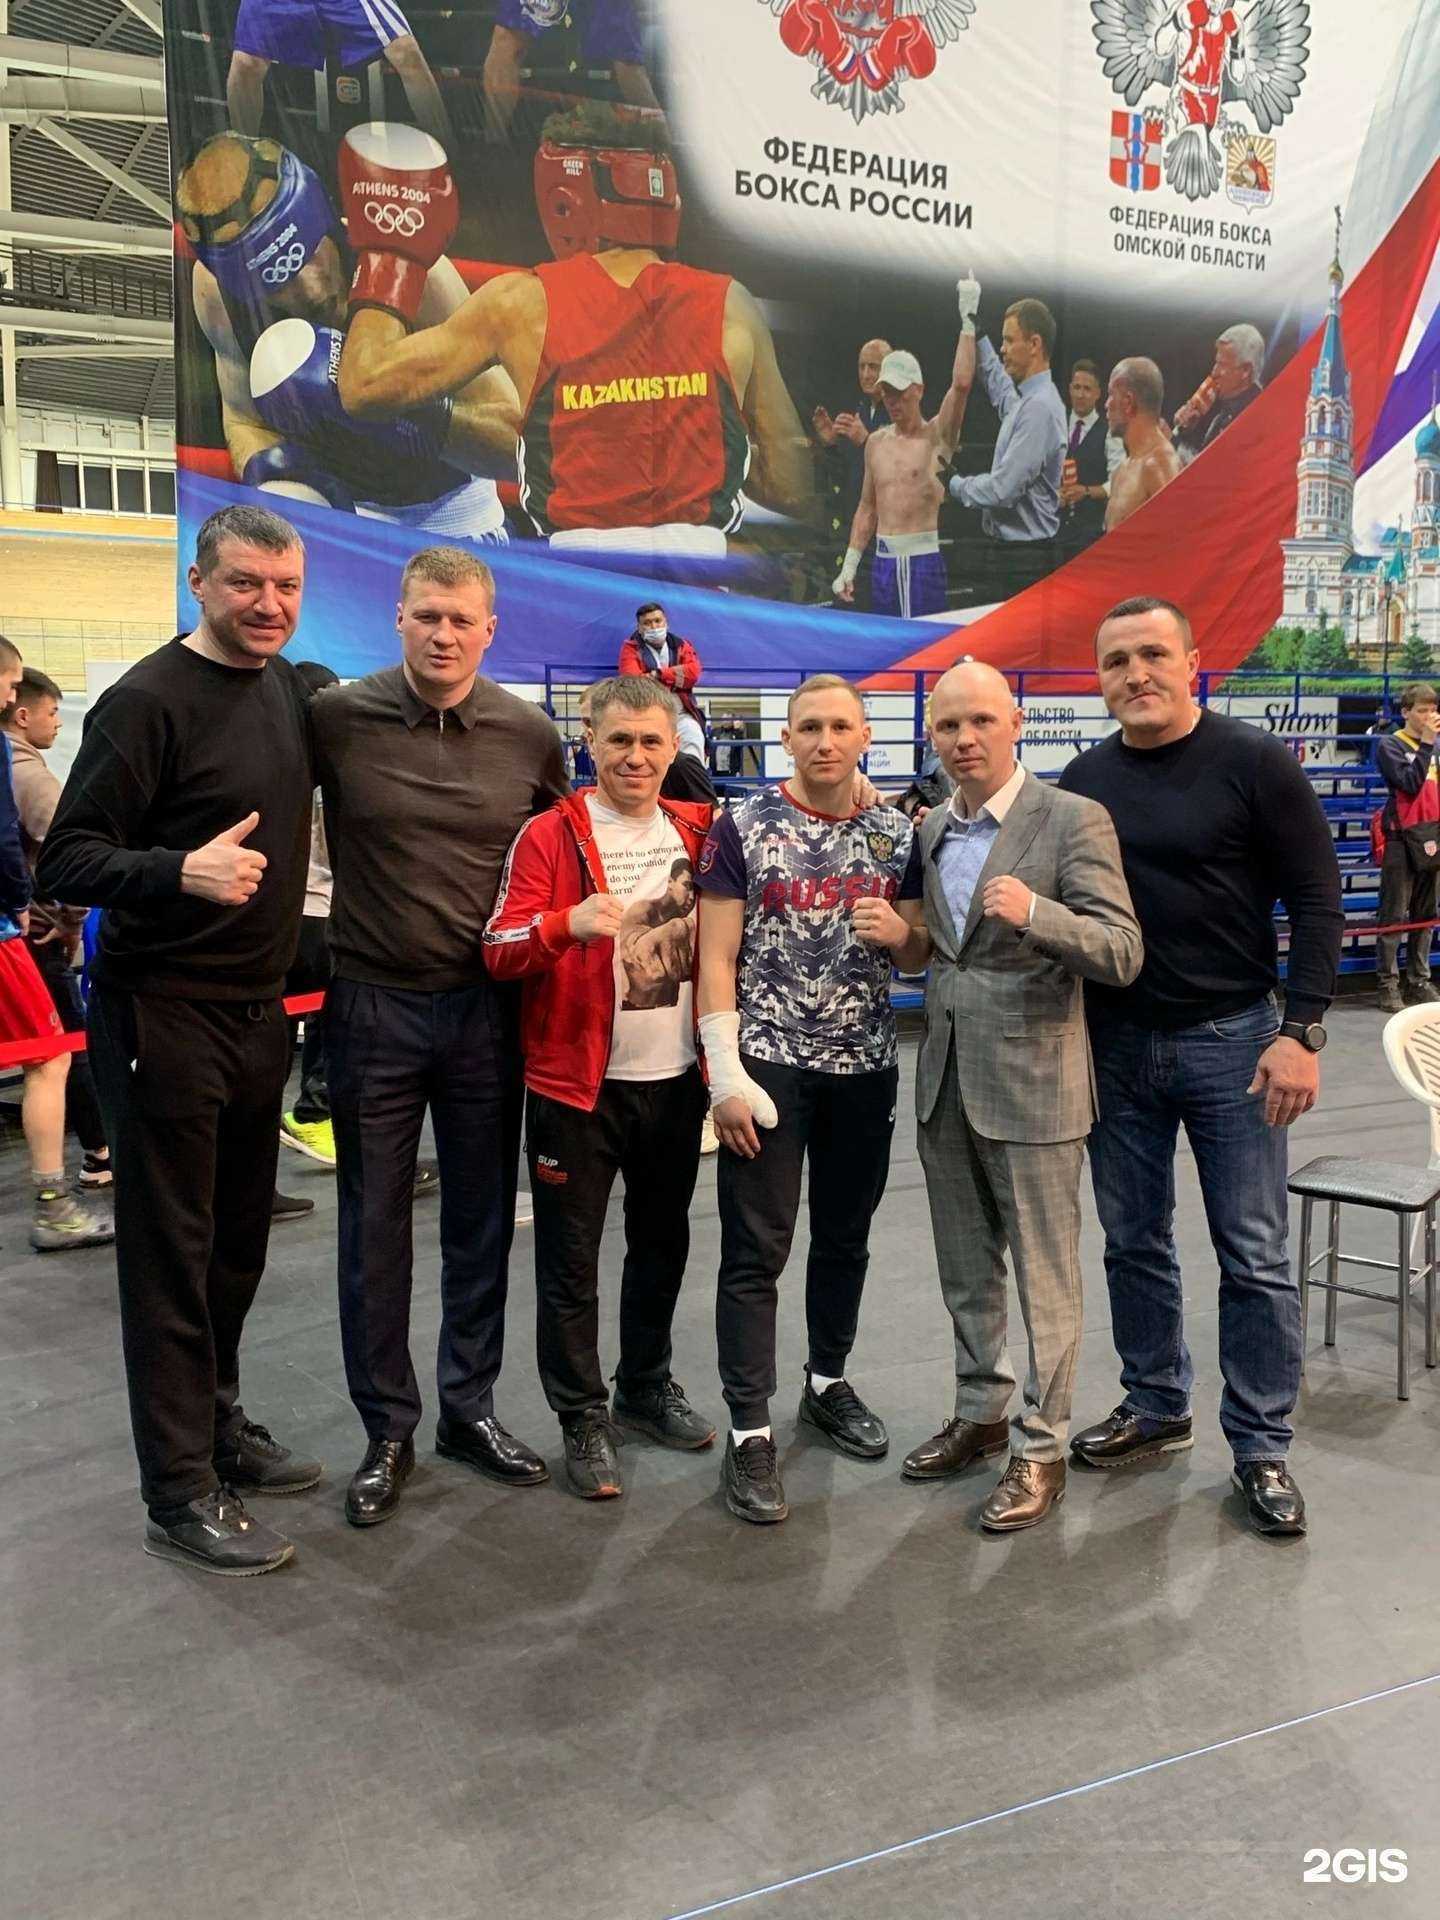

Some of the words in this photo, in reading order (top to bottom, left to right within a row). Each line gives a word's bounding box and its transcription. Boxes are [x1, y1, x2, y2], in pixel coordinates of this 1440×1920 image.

[763, 136, 948, 191] ФЕДЕРАЦИЯ
[352, 181, 399, 198] ATHENS
[400, 187, 431, 204] 2004
[735, 170, 840, 210] БОКСА
[850, 187, 973, 230] РОССИИ
[1109, 205, 1214, 237] ФЕДЕРАЦИЯ
[1219, 222, 1272, 246] БОКСА
[1114, 233, 1185, 260] ОМСКОЙ
[1191, 245, 1265, 271] ОБЛАСТИ
[328, 341, 341, 384] ATHENS
[562, 372, 708, 410] KAZAKHSTAN
[1264, 703, 1334, 733] Show
[609, 874, 621, 883] do
[623, 874, 641, 884] you
